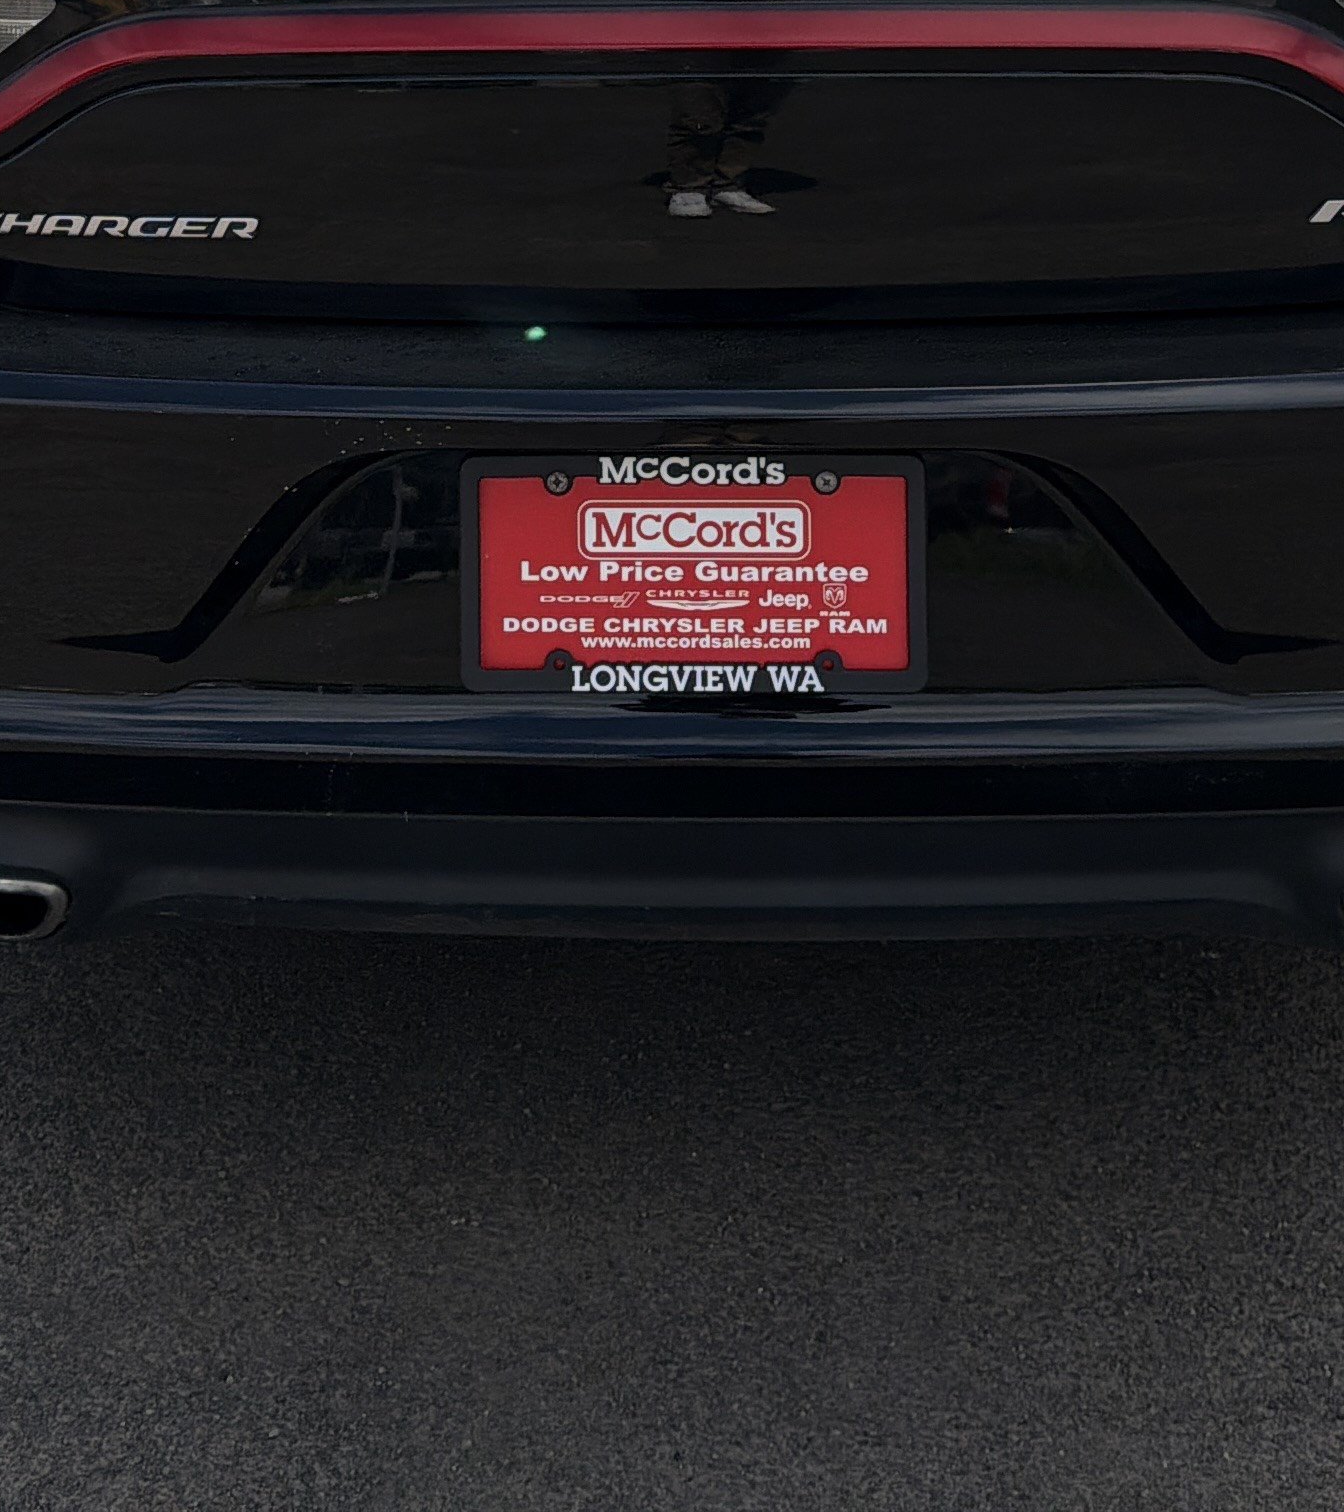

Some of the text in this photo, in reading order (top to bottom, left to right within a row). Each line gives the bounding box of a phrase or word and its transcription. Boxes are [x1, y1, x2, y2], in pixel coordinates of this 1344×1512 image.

[598, 456, 786, 485] McCord's
[591, 511, 797, 548] McCord's
[520, 560, 869, 582] Low Price Guarantee
[539, 595, 625, 603] DODGE
[645, 589, 750, 598] CHRYSLER
[758, 589, 809, 610] Jeep
[503, 617, 888, 634] DODGE CHRYSLER JEEP RAM
[580, 634, 811, 649] www.mccordsales.com
[571, 664, 825, 693] LONGVIEW WA
